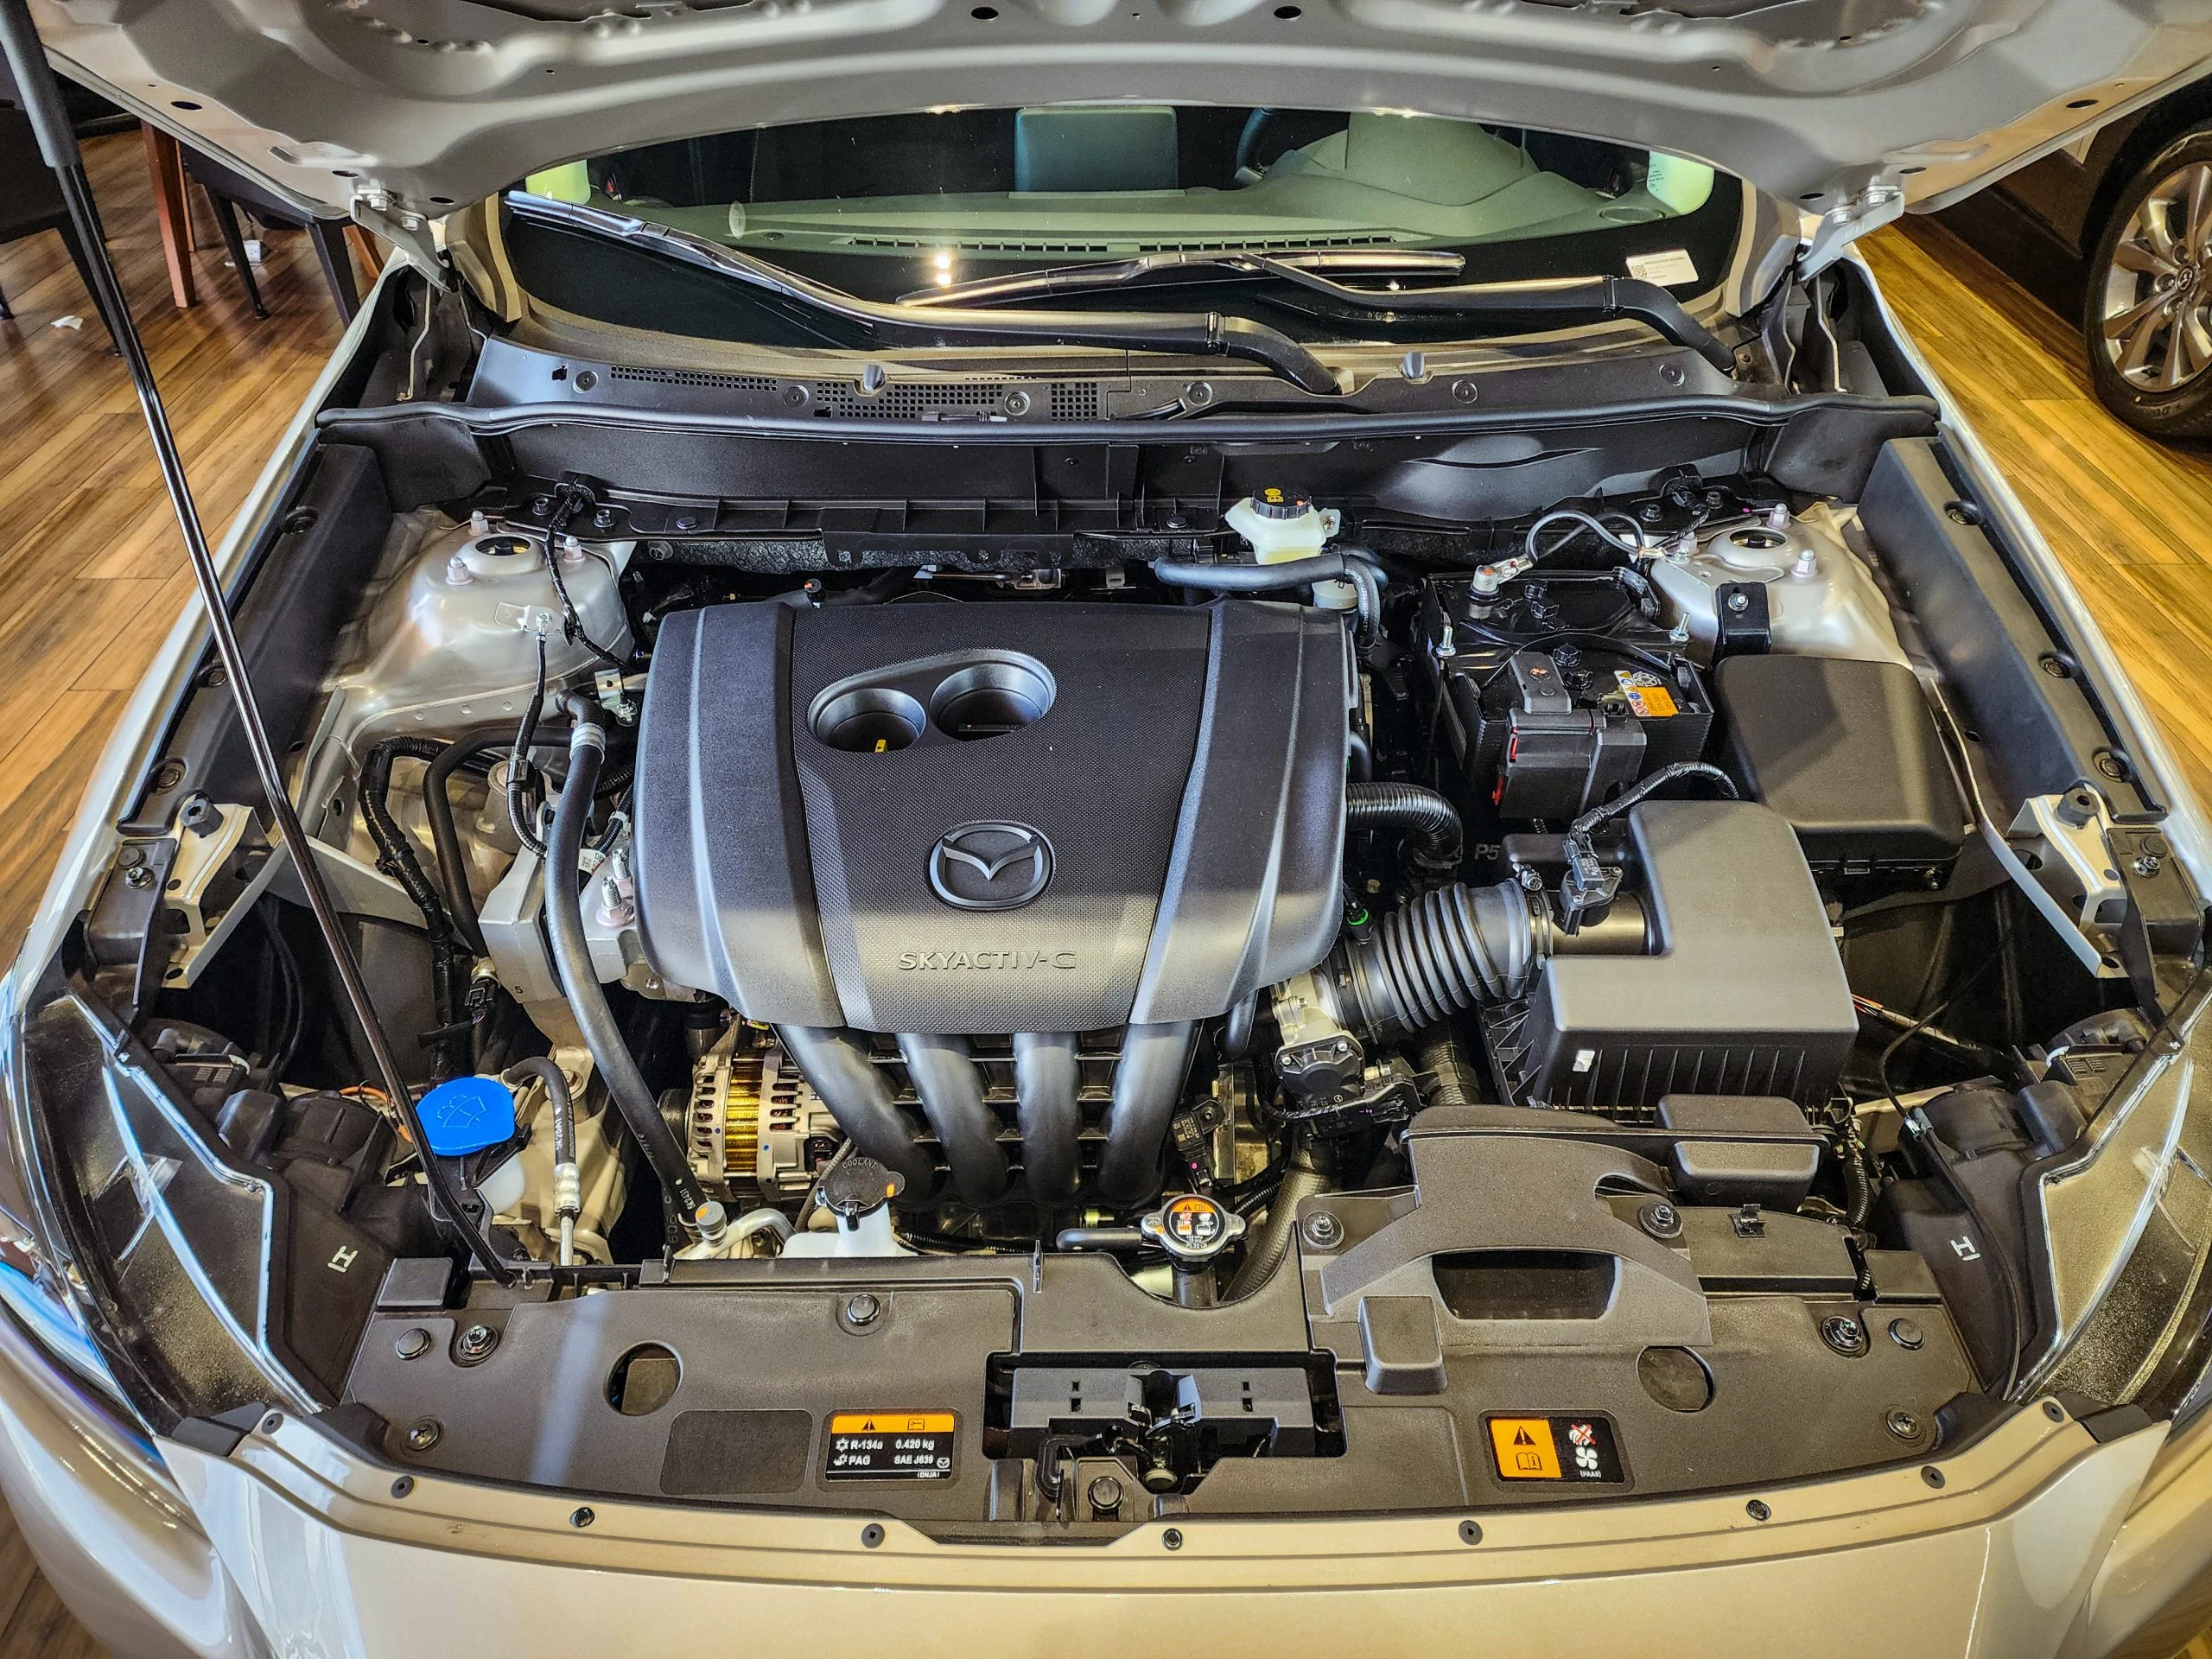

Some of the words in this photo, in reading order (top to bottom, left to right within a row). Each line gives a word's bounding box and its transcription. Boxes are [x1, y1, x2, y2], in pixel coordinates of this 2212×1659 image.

[899, 950, 1077, 970] SKYACTIV-G
[514, 985, 524, 994] 5
[842, 1158, 879, 1169] COOLANT
[850, 1439, 883, 1450] R-134a
[895, 1439, 920, 1450] 0.420
[922, 1438, 934, 1451] kg
[849, 1455, 871, 1465] PAG
[894, 1454, 912, 1465] SAE
[913, 1454, 934, 1465] J639
